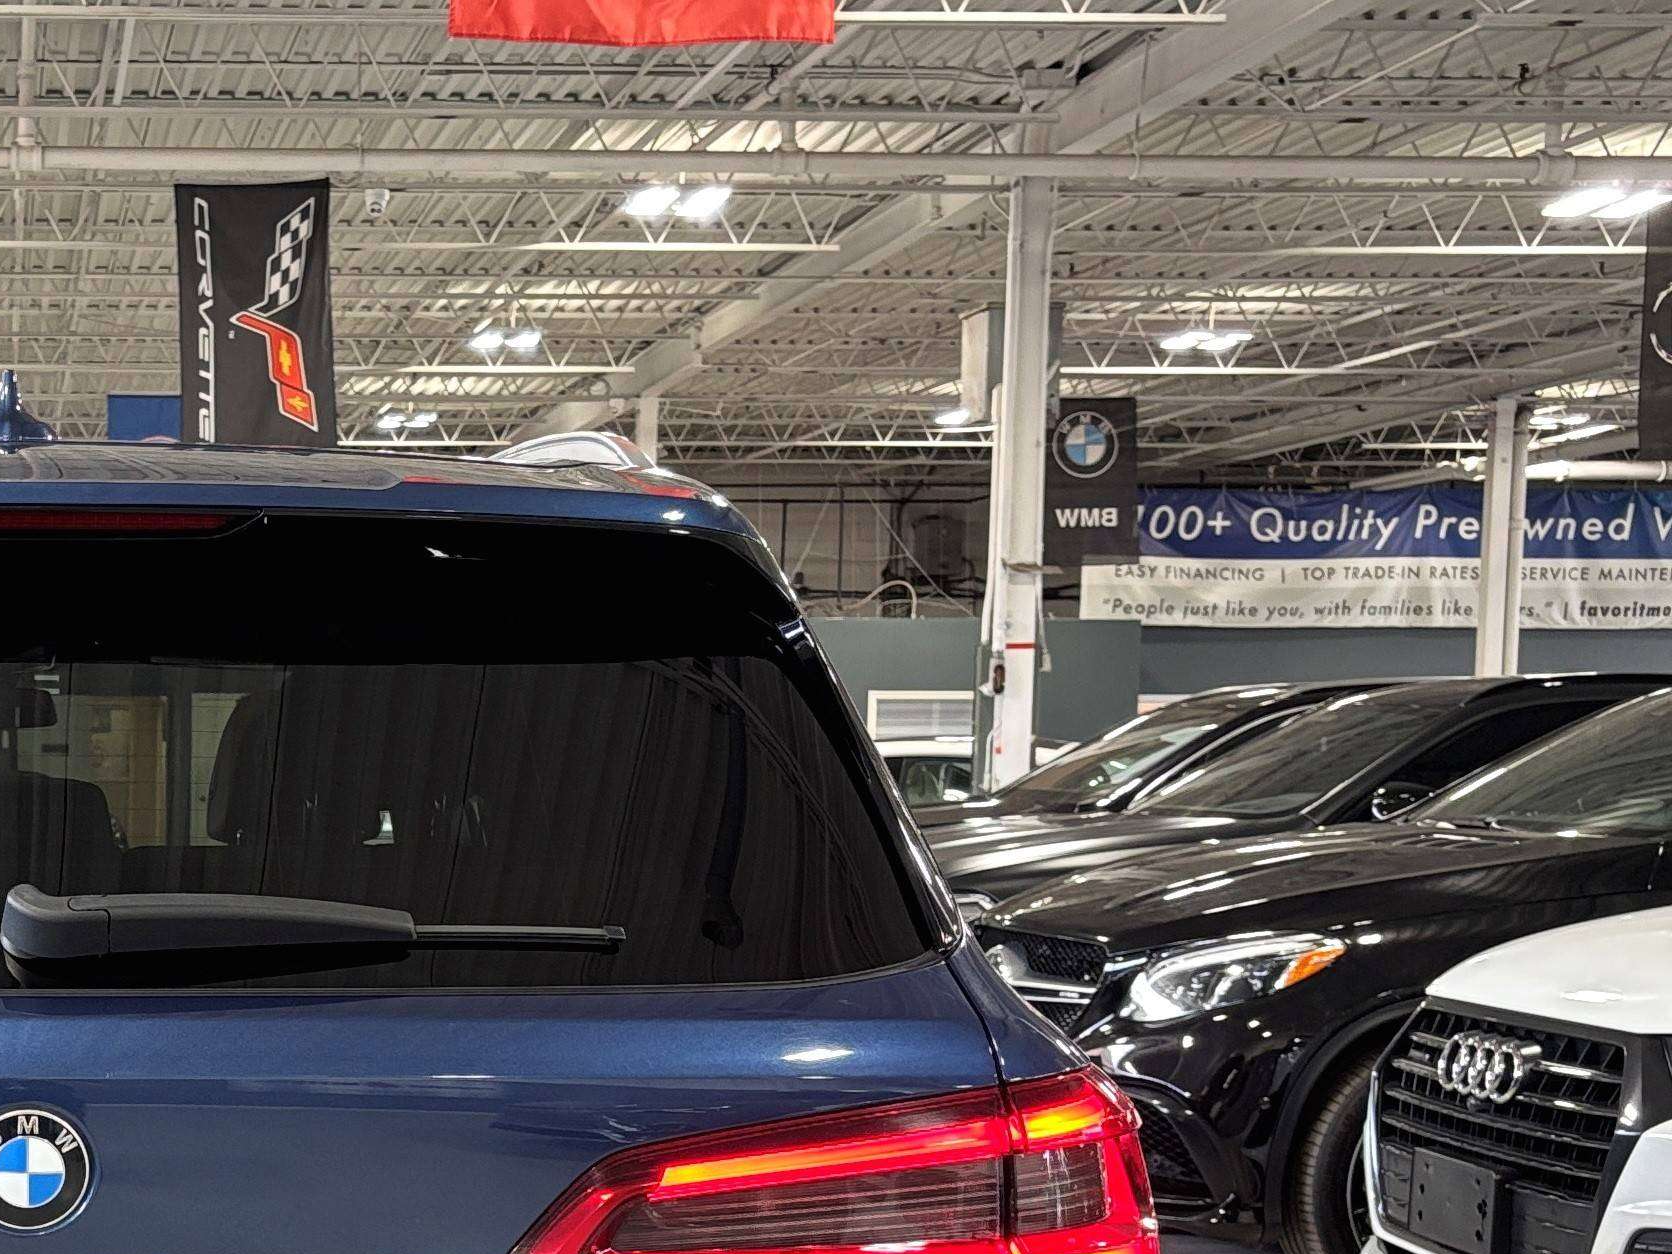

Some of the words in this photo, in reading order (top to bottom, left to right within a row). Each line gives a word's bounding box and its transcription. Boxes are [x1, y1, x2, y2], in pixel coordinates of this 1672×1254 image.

[193, 196, 216, 444] CORVETTE
[1249, 503, 1400, 551] Quality
[1114, 564, 1158, 579] EASY
[1165, 565, 1265, 581] FINANCING
[1301, 566, 1337, 581] TOP
[1344, 566, 1421, 580] TRADE-IN
[1429, 566, 1481, 580] RATES
[1520, 566, 1591, 581] SERVICE
[1598, 567, 1672, 582] MAINTE
[1183, 599, 1219, 619] just
[1224, 600, 1259, 618] like
[1313, 599, 1352, 618] with
[1359, 598, 1433, 617] families
[1440, 598, 1474, 617] like
